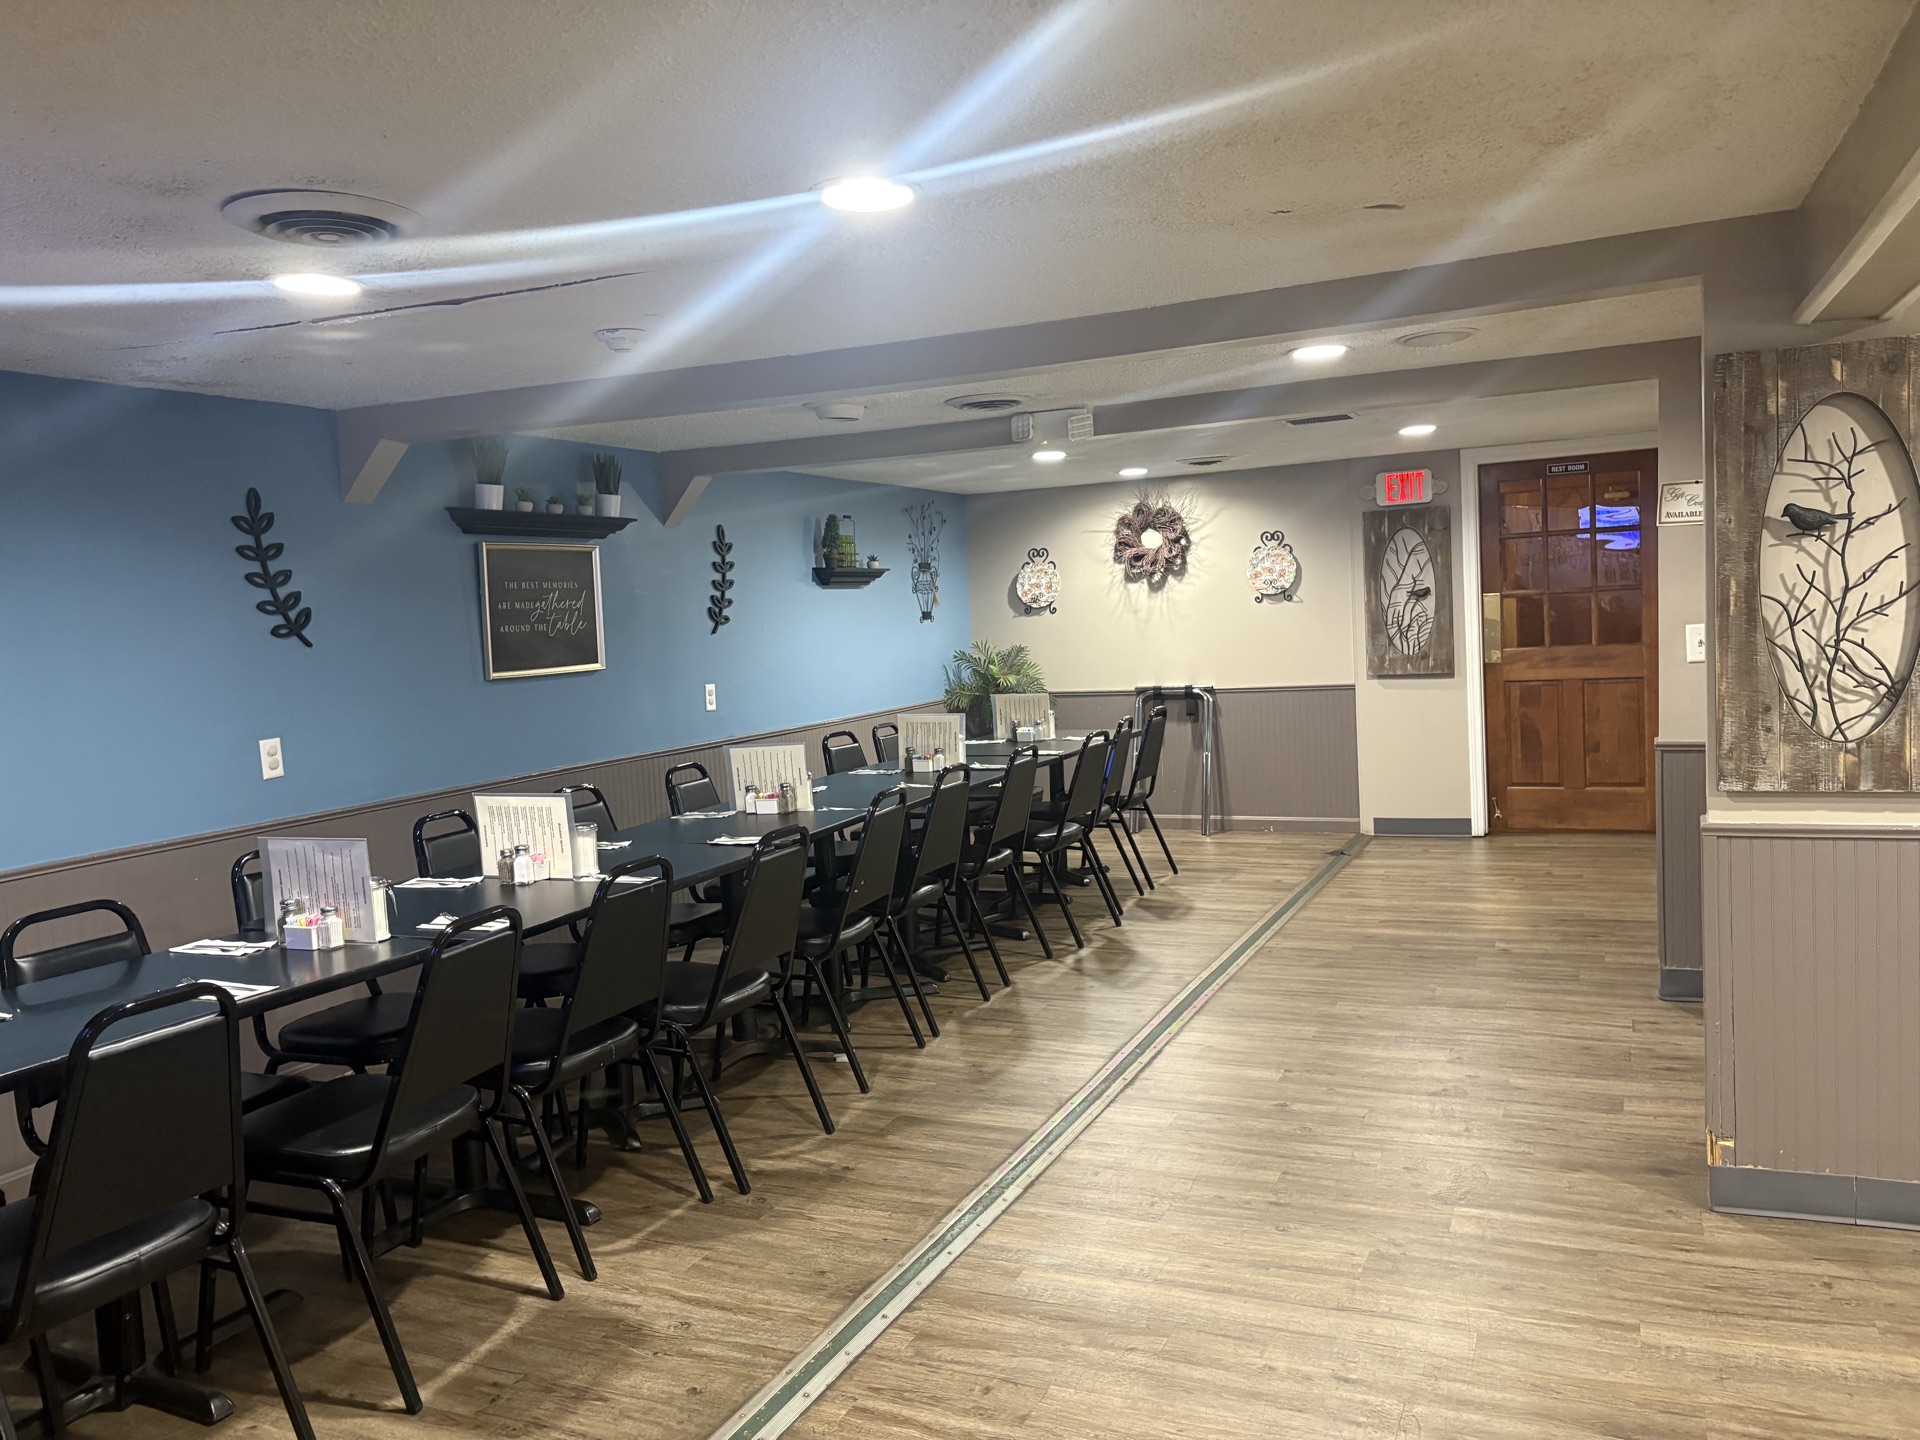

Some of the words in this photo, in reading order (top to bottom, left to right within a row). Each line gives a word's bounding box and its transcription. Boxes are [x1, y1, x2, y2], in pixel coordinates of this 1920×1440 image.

[1385, 470, 1425, 504] EXIT
[1664, 487, 1686, 502] Gift
[1664, 510, 1704, 519] AVAILABLE
[504, 581, 518, 589] THE
[521, 581, 539, 589] BEST
[542, 581, 578, 589] MEMORIES
[497, 602, 511, 610] ARE
[514, 601, 535, 610] MADE
[530, 590, 587, 621] gathered
[499, 624, 531, 633] AROUND
[534, 623, 547, 631] THE
[546, 610, 587, 637] table
